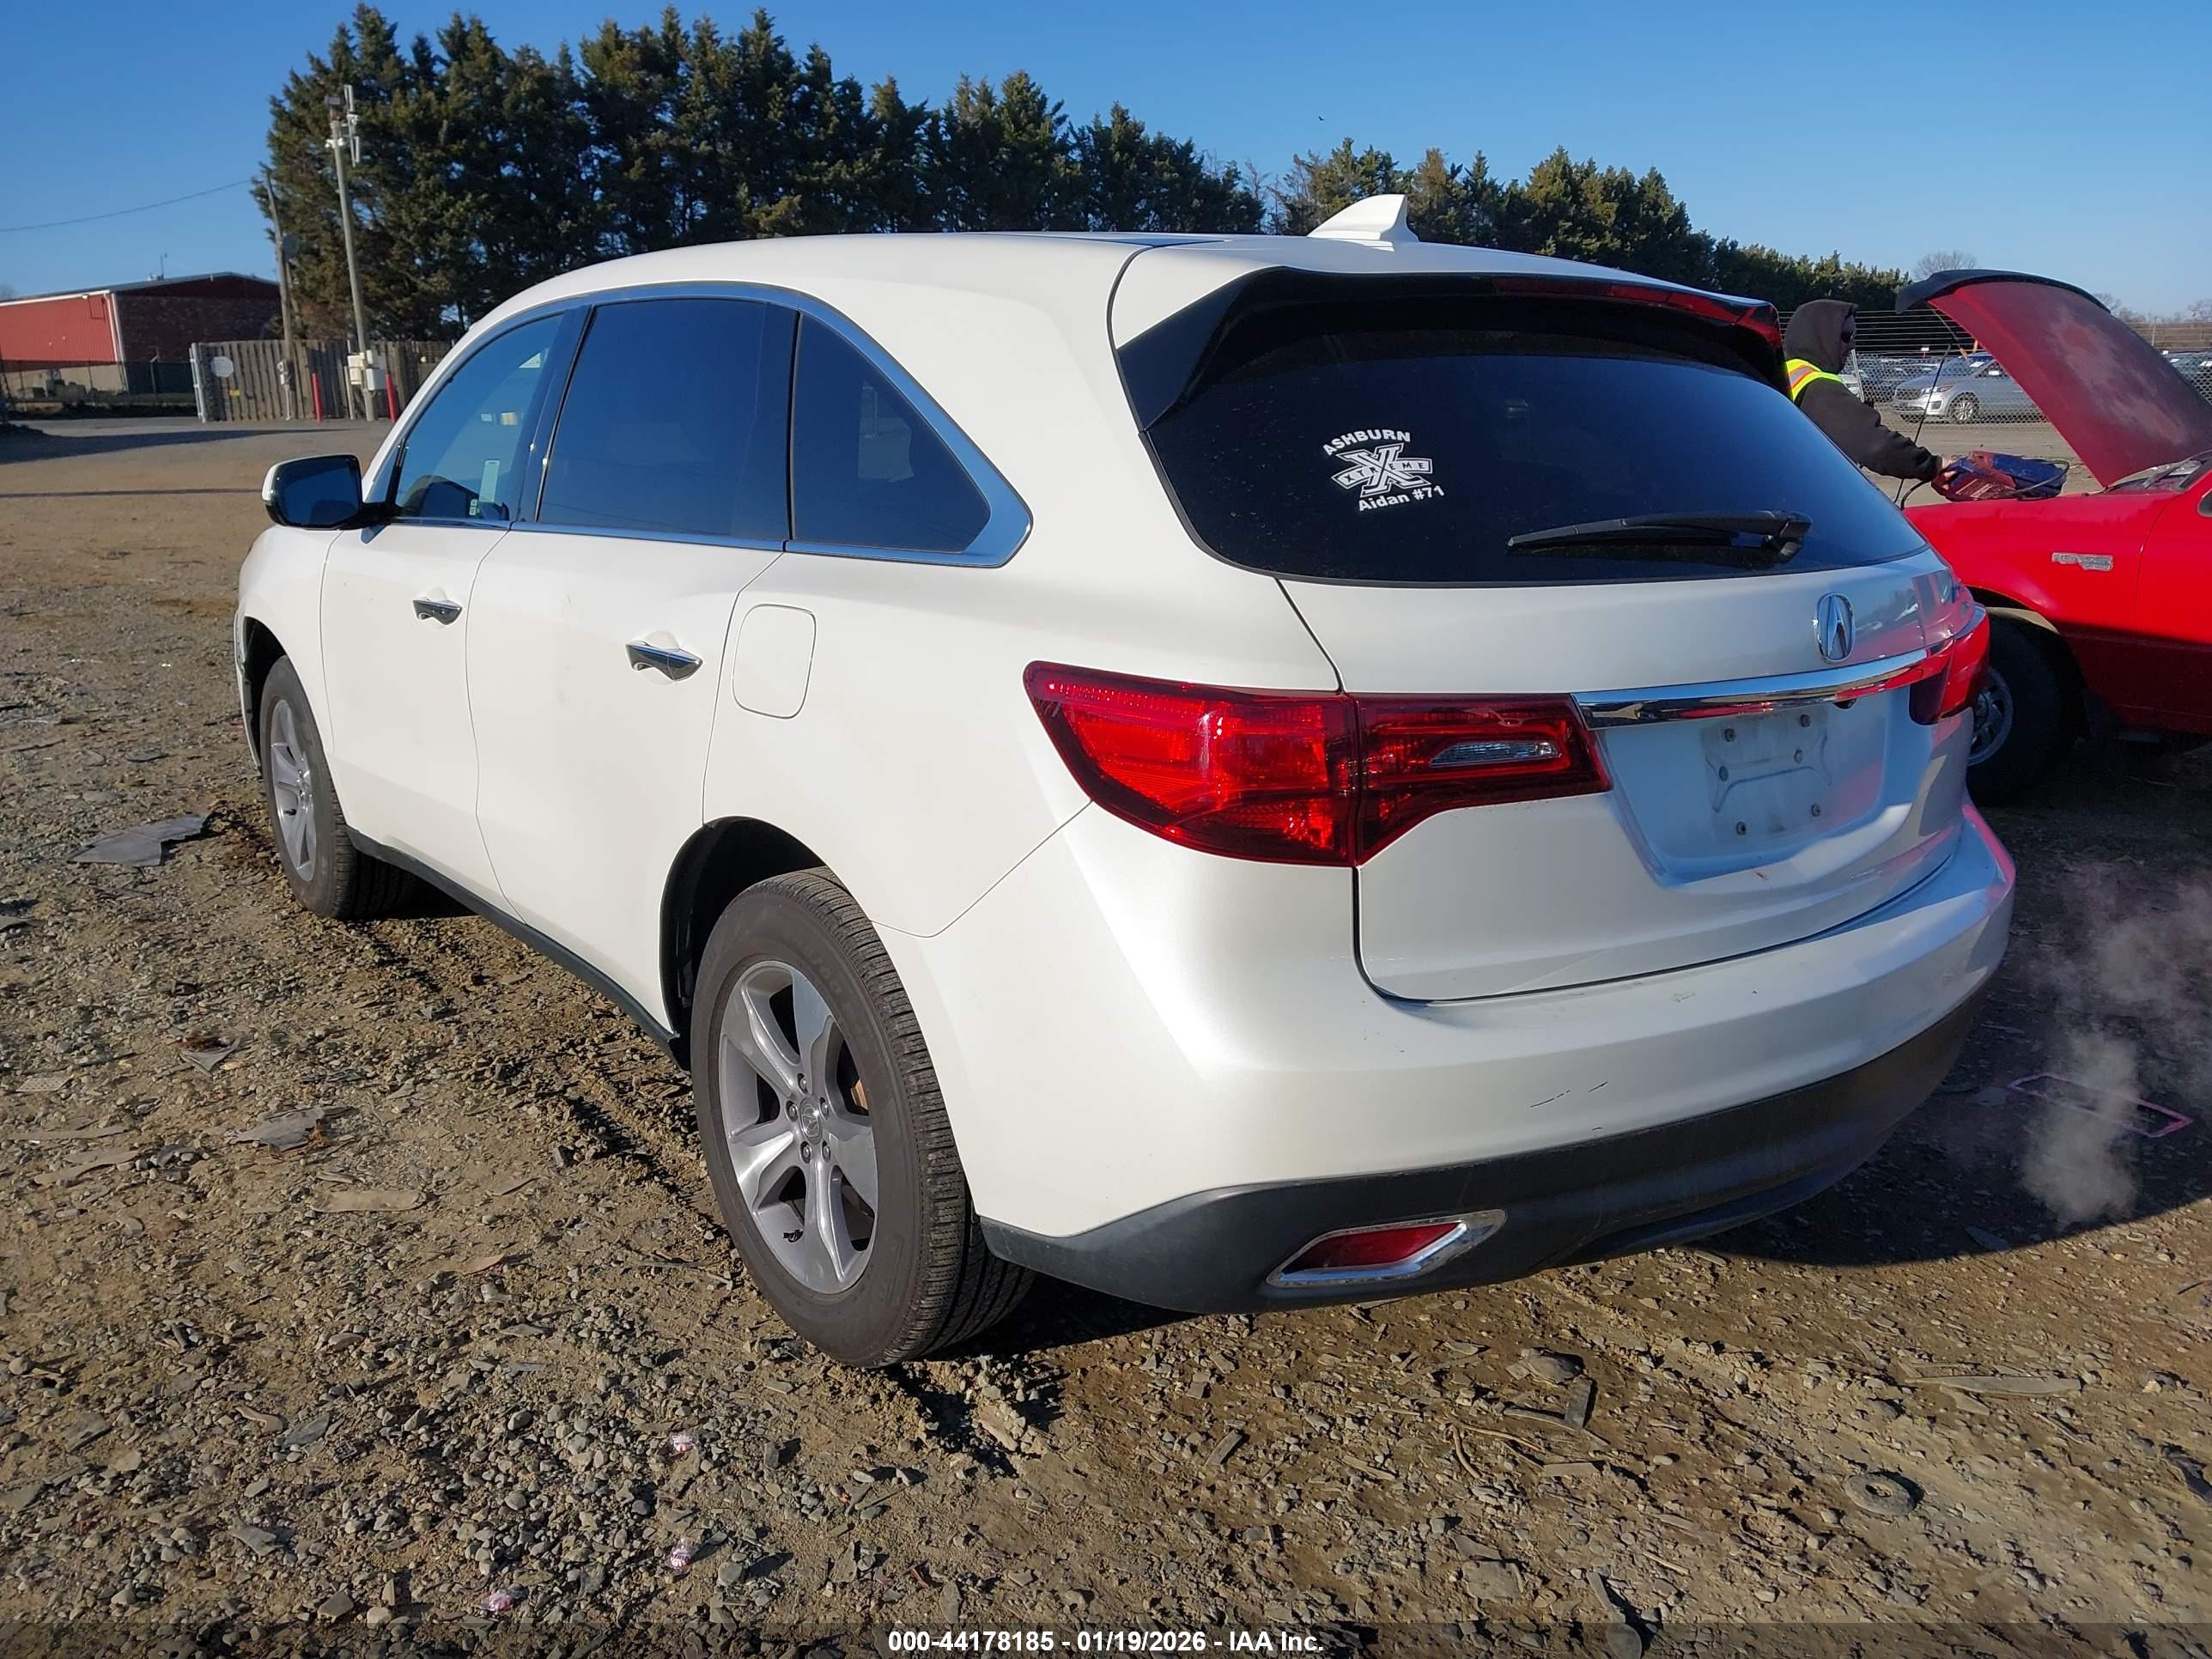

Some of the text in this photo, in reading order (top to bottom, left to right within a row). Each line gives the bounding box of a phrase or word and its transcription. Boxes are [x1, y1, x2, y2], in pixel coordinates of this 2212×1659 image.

[1322, 428, 1411, 456] ASHBURN
[1358, 485, 1445, 512] Aidan #71
